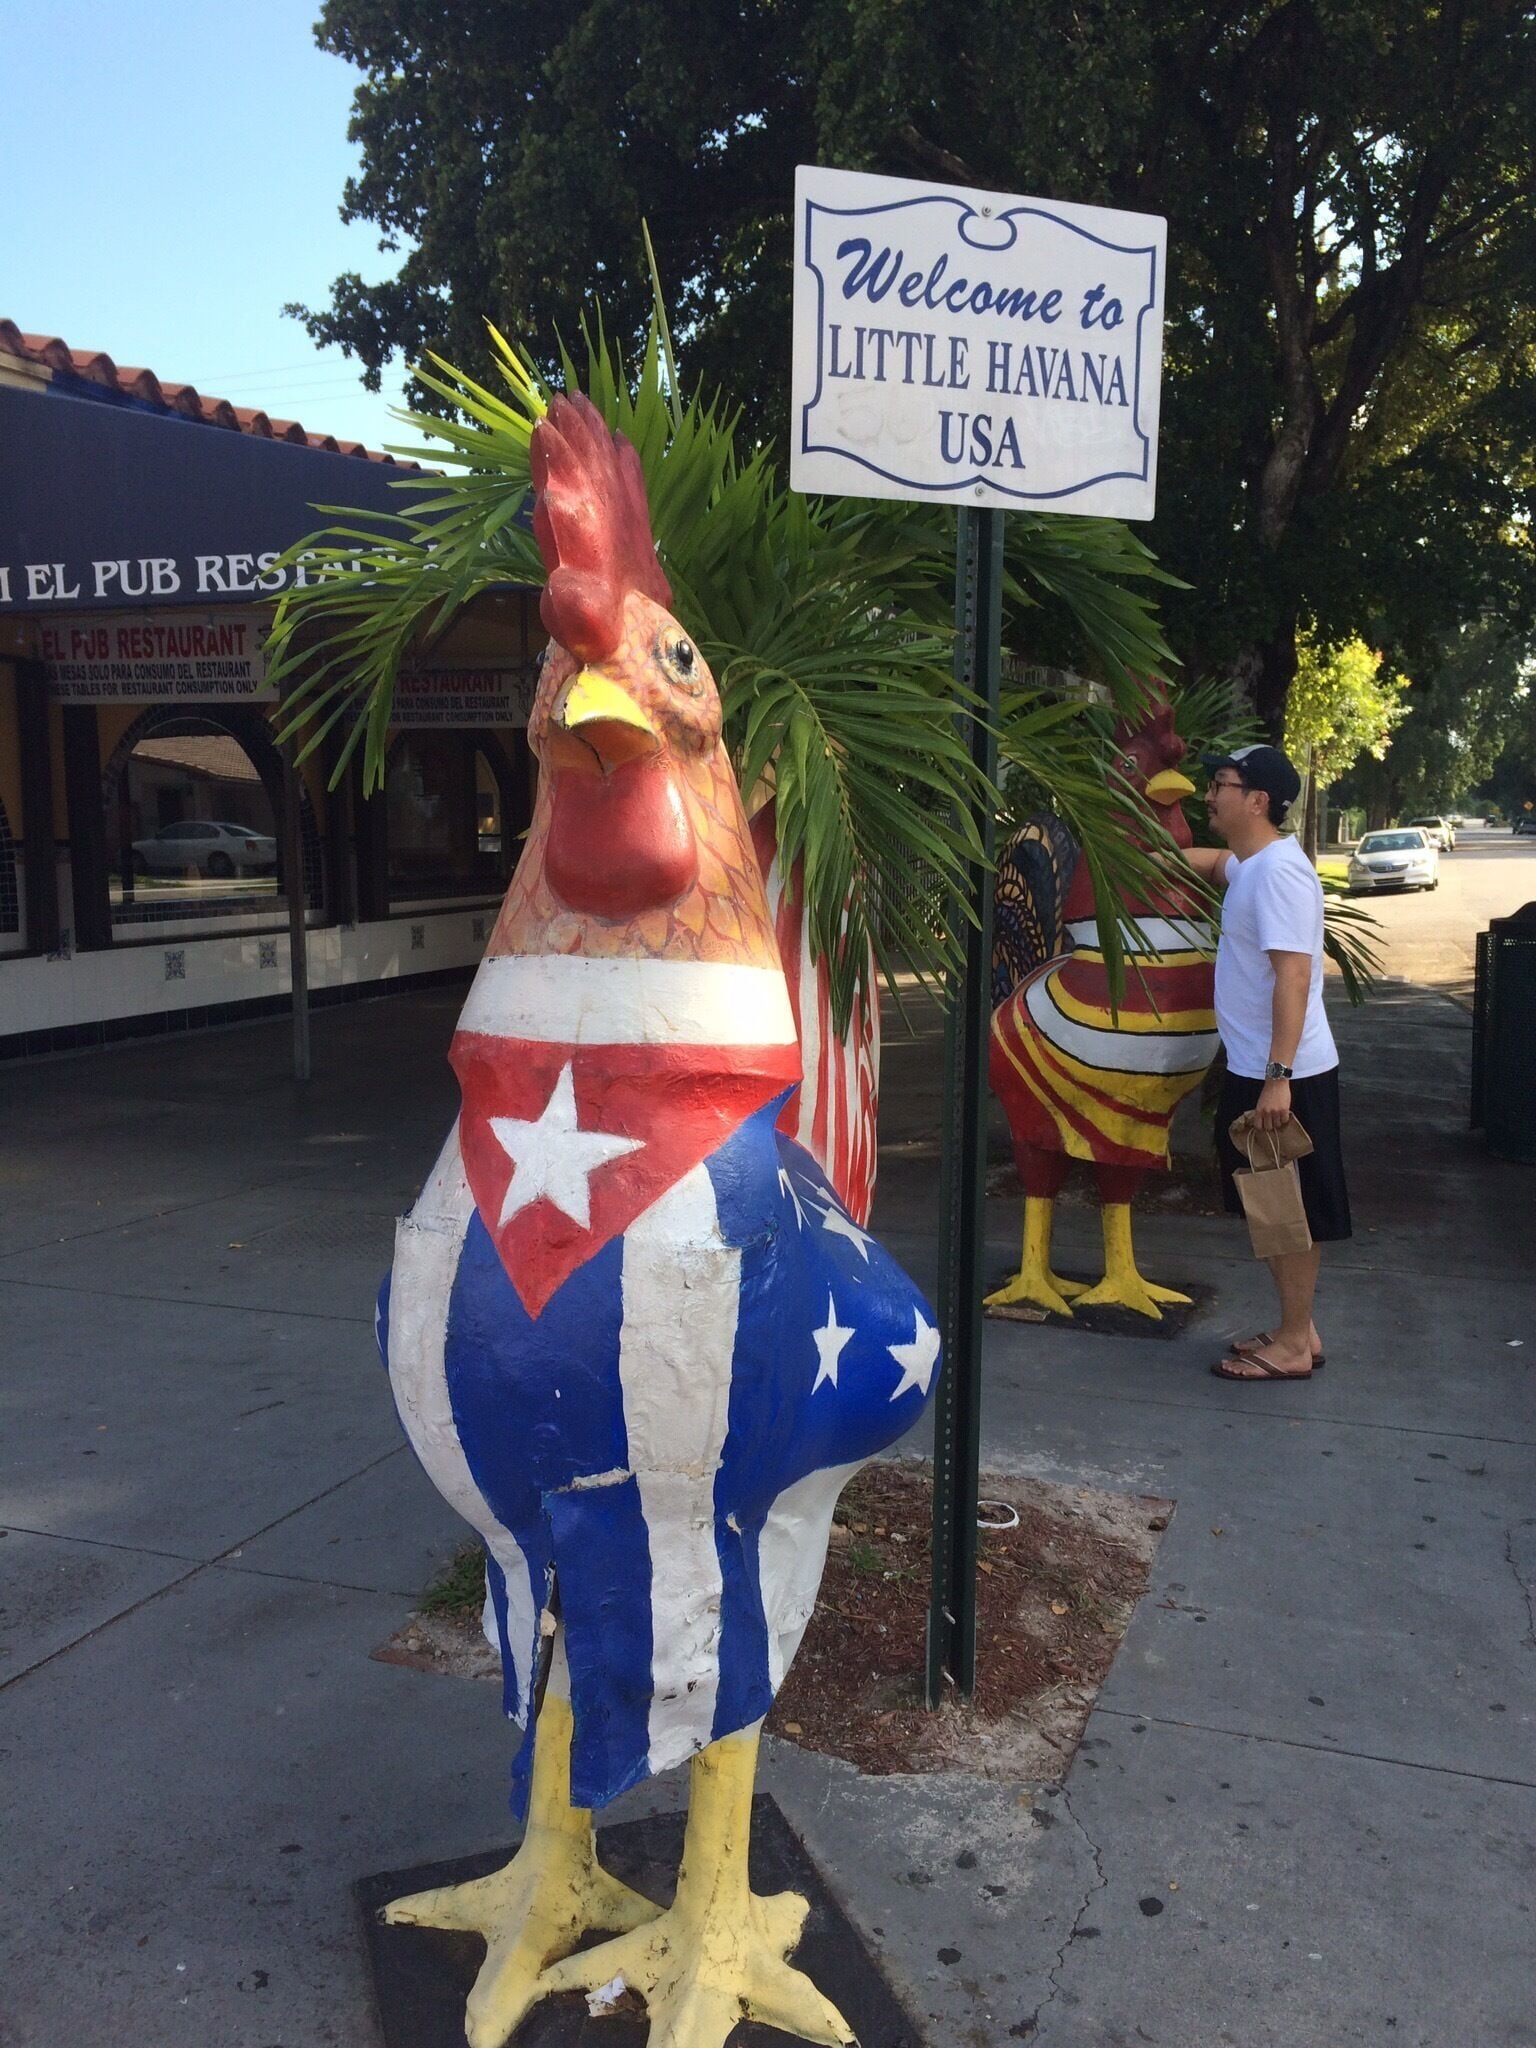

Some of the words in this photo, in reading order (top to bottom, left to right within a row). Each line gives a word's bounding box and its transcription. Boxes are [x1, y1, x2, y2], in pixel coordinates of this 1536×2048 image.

[837, 237, 1062, 324] Welcome
[1080, 283, 1124, 330] to
[828, 324, 970, 390] LITTLE
[986, 340, 1130, 407] HAVANA
[938, 410, 1026, 469] USA
[25, 563, 80, 600] EL
[92, 558, 181, 597] PUB
[42, 629, 65, 660] EL
[71, 628, 109, 659] PUB
[118, 625, 246, 659] RESTAURANT
[88, 663, 109, 680] SOLO
[110, 663, 133, 680] PARA
[134, 663, 175, 680] CONSUMO
[178, 663, 194, 680] DEL
[196, 661, 251, 679] RESTAURANT
[103, 682, 119, 696] FOR
[121, 681, 173, 695] RESTAURANT
[176, 680, 234, 695] CONSUMPTION
[236, 680, 258, 694] ONLY
[400, 673, 502, 692] RESTAURANT
